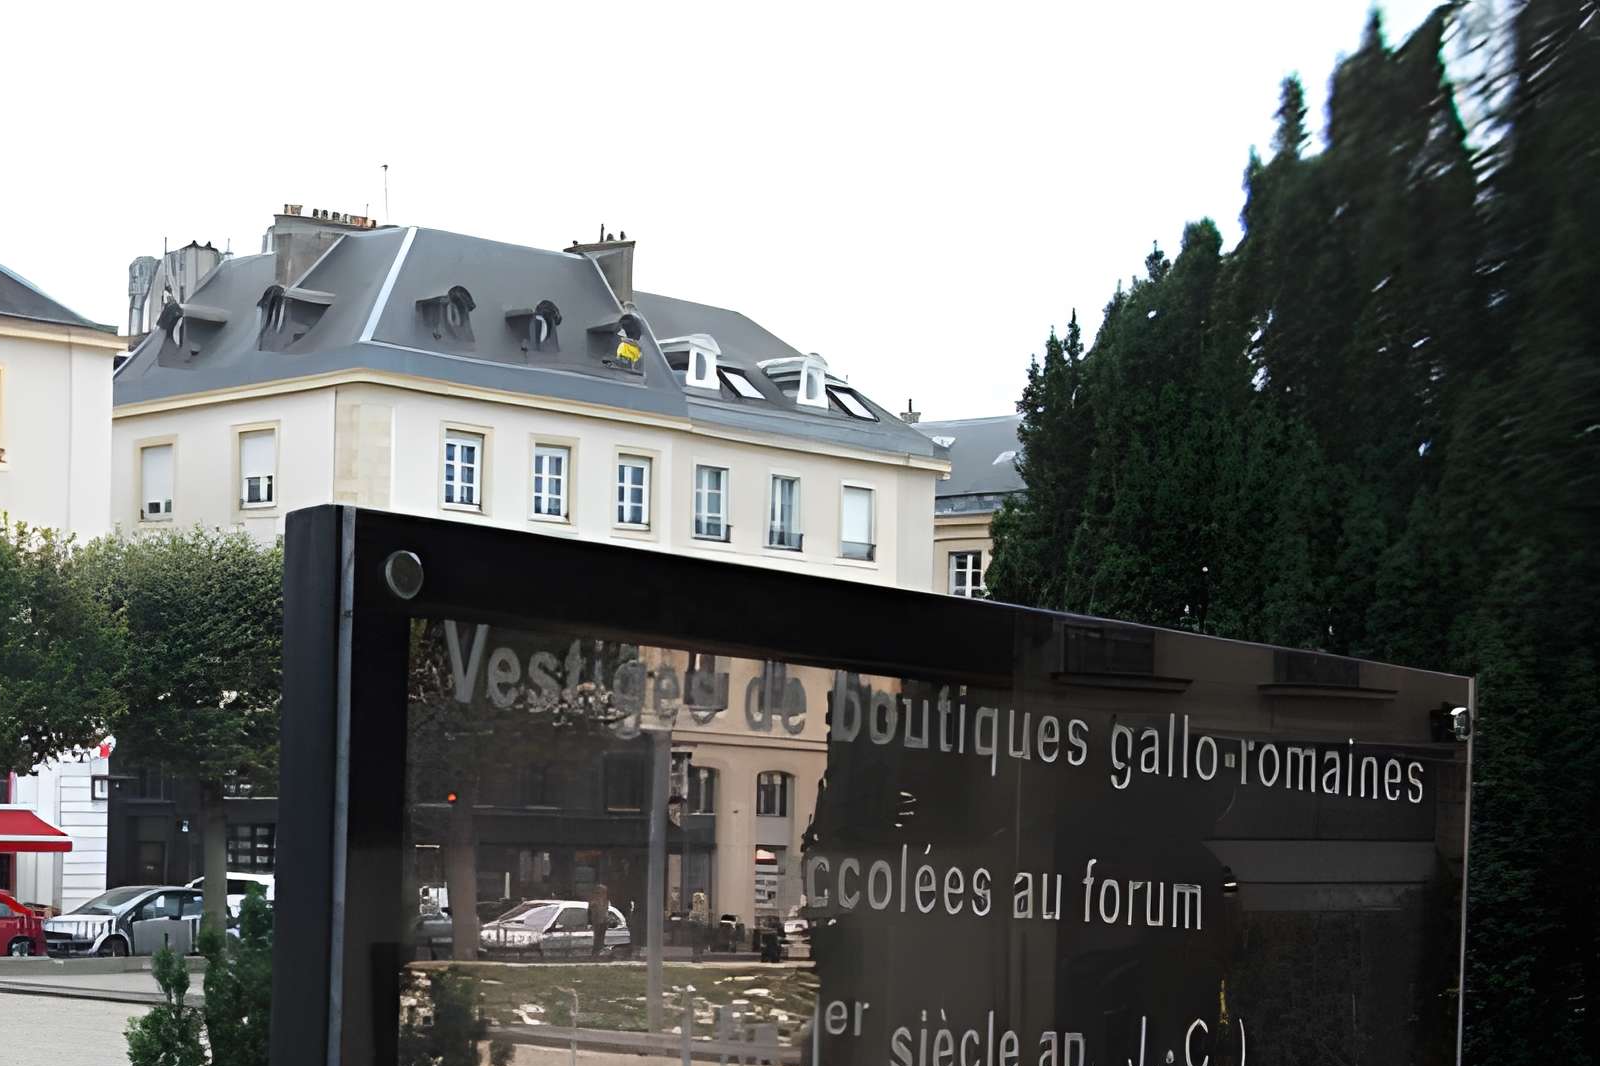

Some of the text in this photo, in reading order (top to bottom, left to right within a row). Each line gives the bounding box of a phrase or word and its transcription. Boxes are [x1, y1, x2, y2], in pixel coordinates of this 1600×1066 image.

[745, 659, 808, 735] de
[831, 669, 1087, 776] boutiques
[1110, 711, 1424, 804] gallo-romaines
[1013, 871, 1063, 919] au
[1083, 858, 1202, 930] forum
